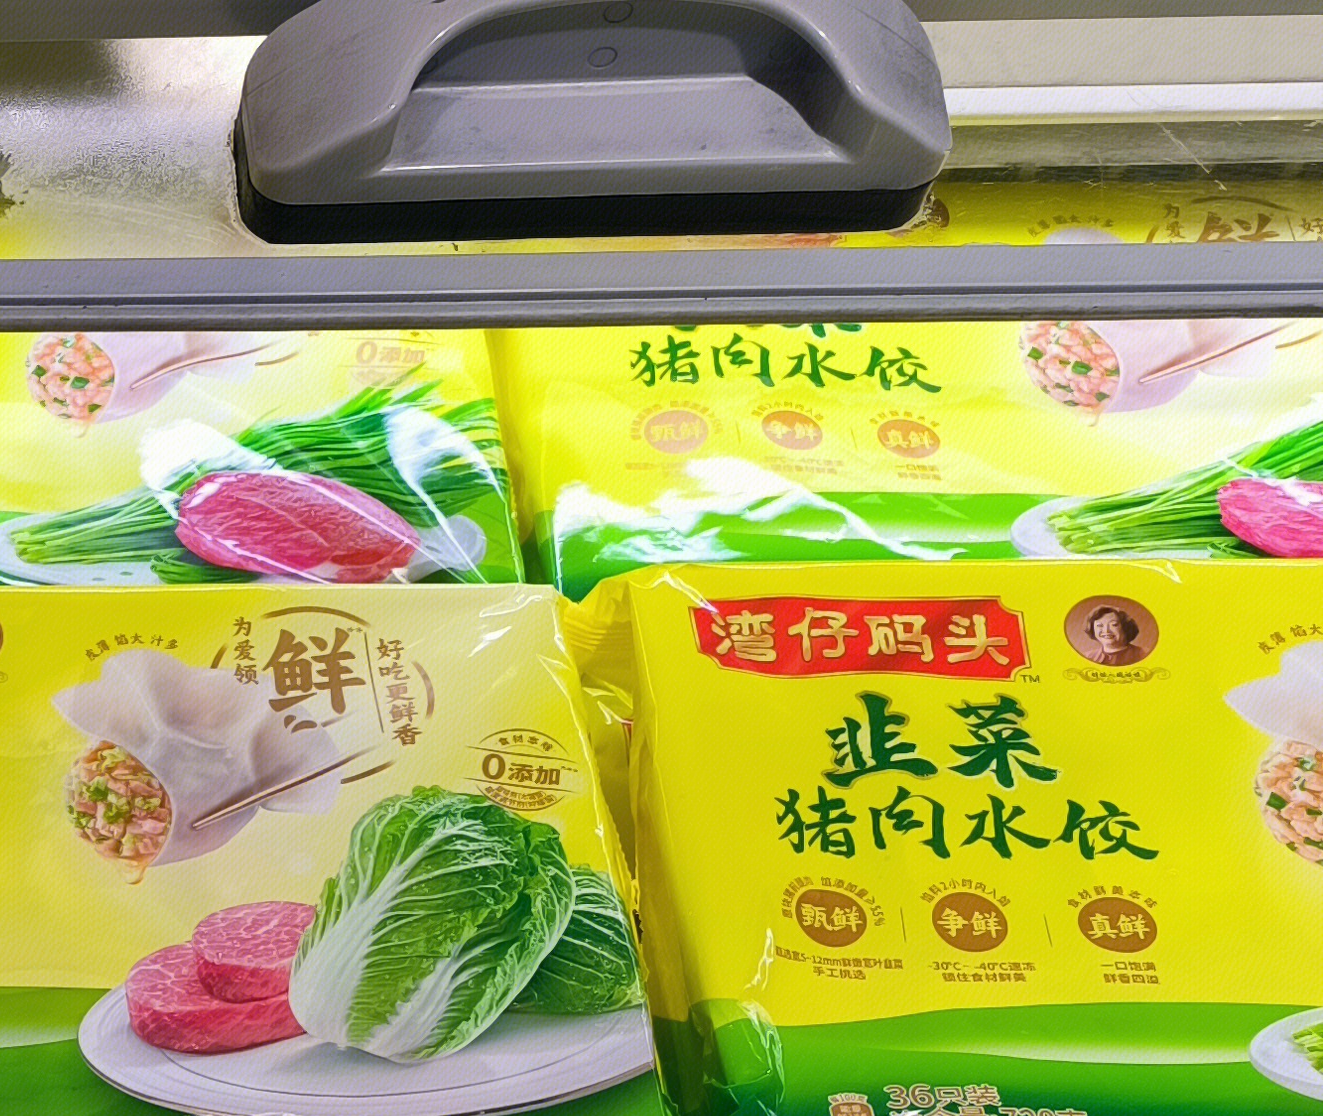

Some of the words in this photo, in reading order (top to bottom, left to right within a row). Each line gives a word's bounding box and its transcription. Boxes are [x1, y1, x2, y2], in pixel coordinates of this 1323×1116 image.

[628, 332, 943, 394] 猪肉水饺
[710, 608, 1011, 668] 湾仔码头
[1019, 673, 1041, 684] TM
[232, 616, 259, 686] 为爱领
[261, 626, 367, 716] 鲜
[375, 637, 423, 747] 好吃更鲜香
[824, 690, 1059, 789] 韭菜
[481, 753, 561, 786] 0添加
[774, 786, 1160, 861] 猪肉水饺
[800, 903, 864, 934] 甄鲜
[936, 906, 1003, 940] 争鲜
[1087, 912, 1151, 941] 真鲜
[884, 1083, 1003, 1109] 36只装
